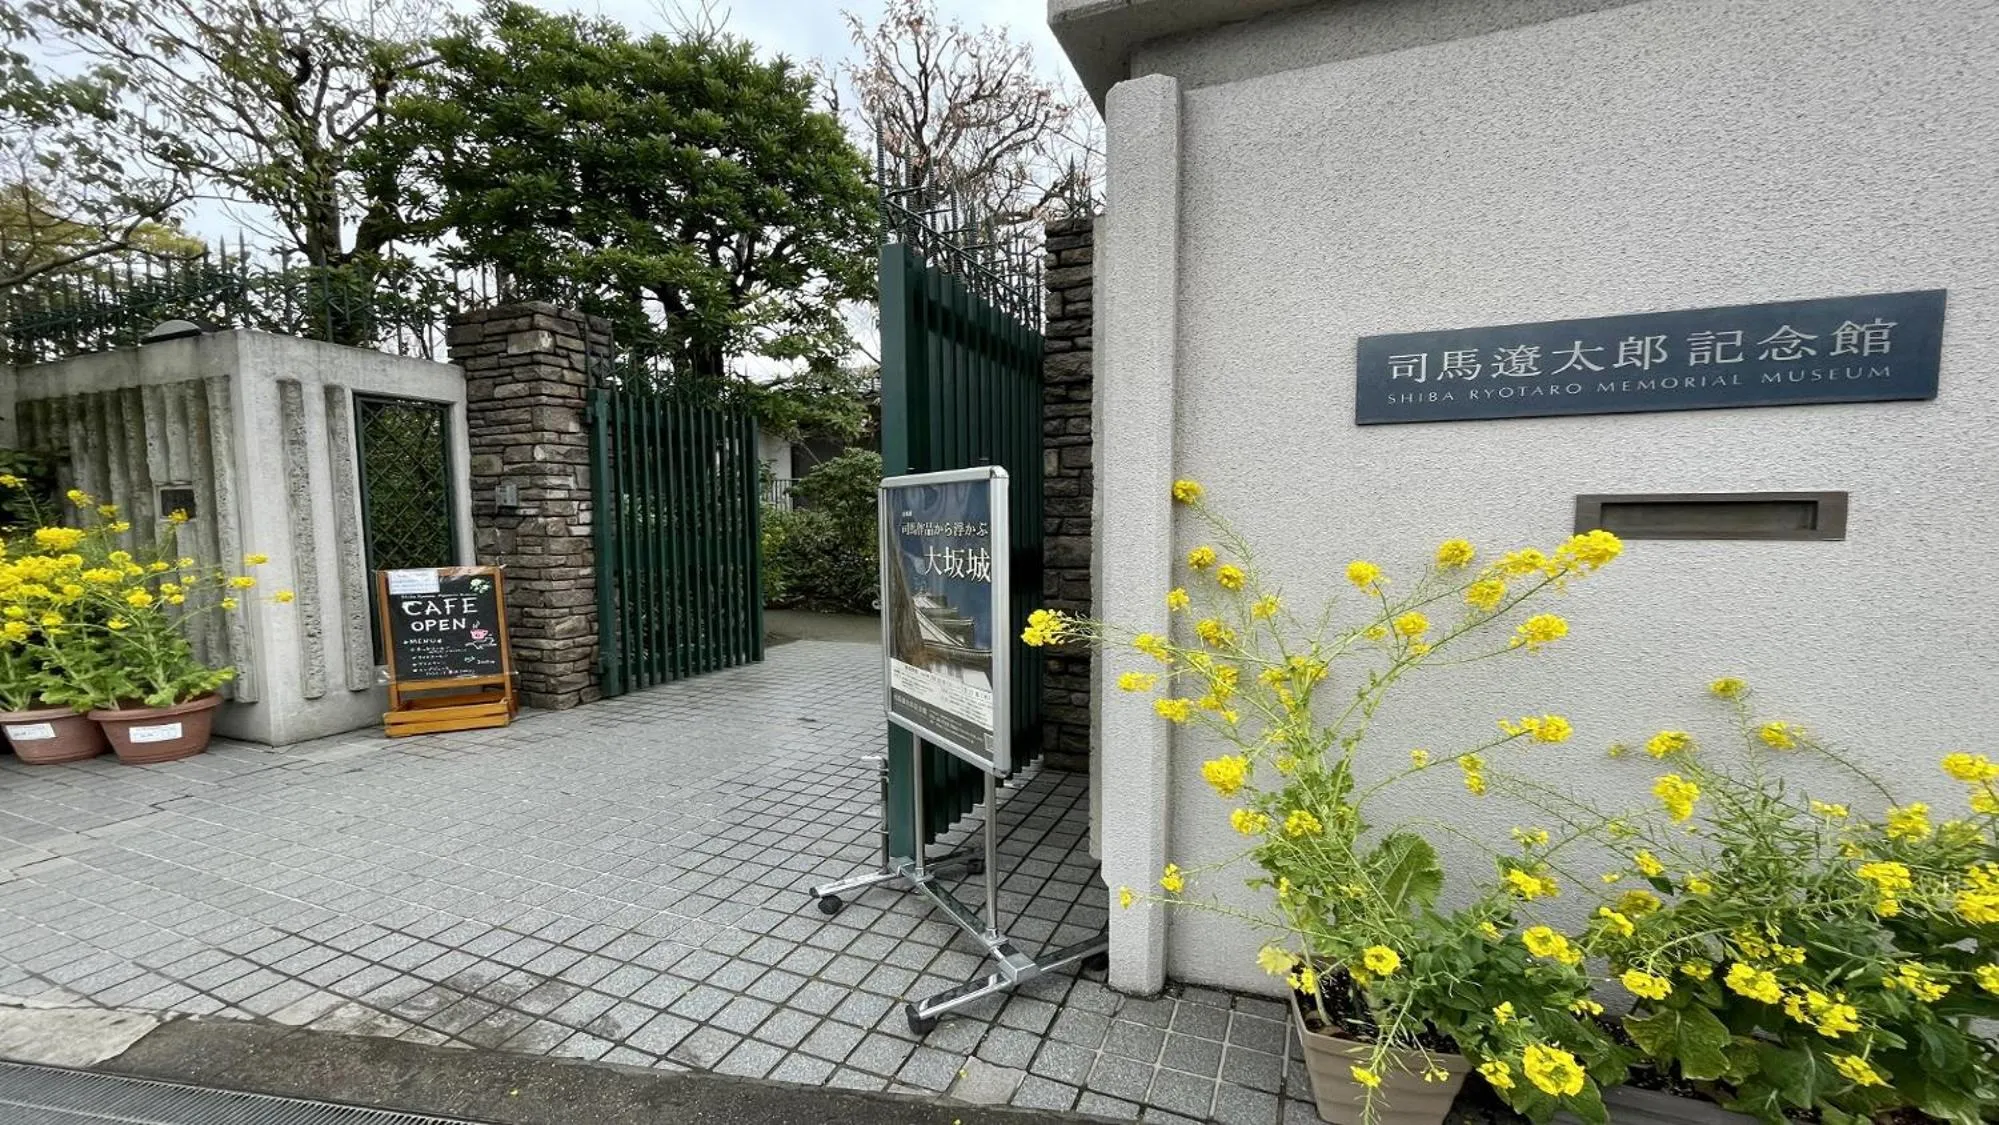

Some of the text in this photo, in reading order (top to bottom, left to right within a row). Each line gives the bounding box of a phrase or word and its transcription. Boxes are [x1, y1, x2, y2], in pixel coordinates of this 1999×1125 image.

[1387, 317, 1898, 383] 司馬遼太郎記念館
[1388, 366, 1890, 404] SHIBA RYOTARO MEMORIAL MUSEUM
[924, 545, 991, 583] 大坂城
[401, 597, 478, 616] CAFE
[410, 618, 466, 632] OPEN
